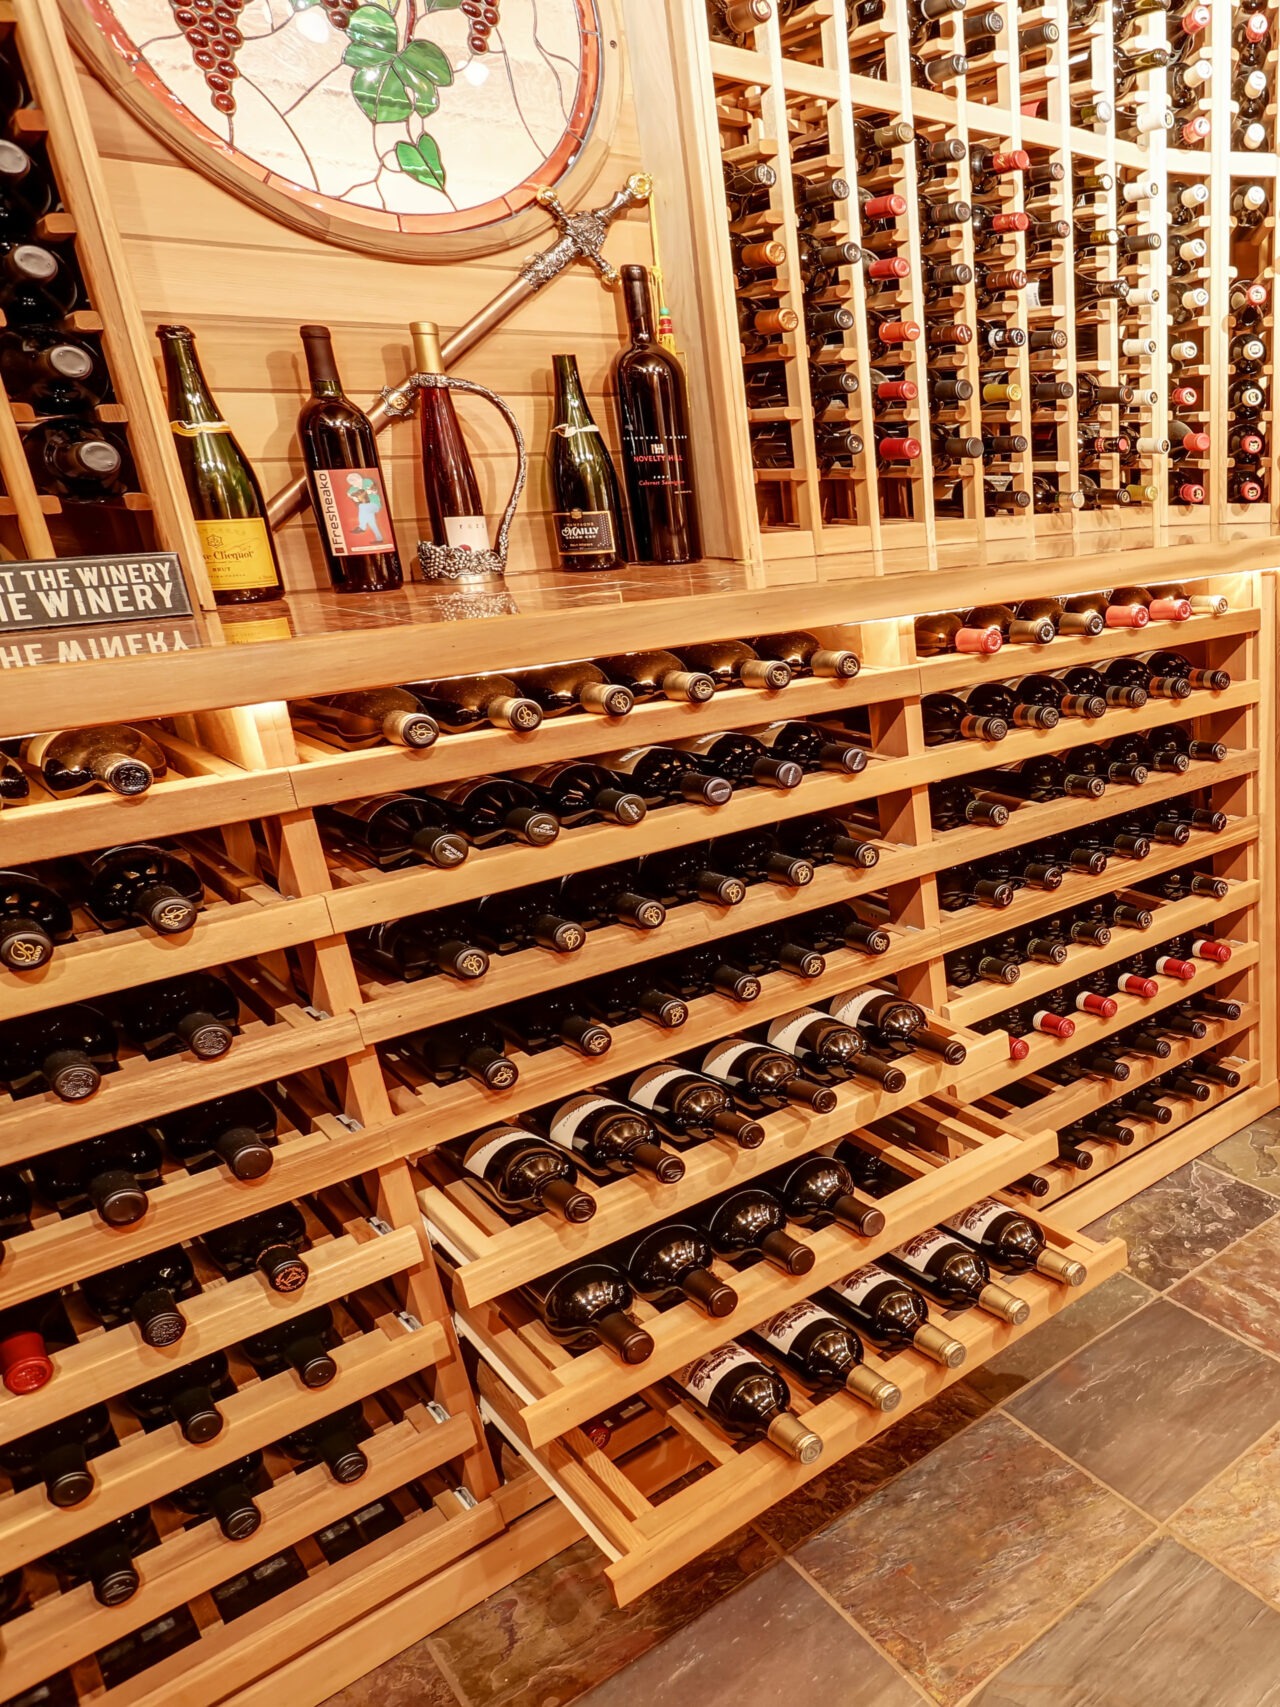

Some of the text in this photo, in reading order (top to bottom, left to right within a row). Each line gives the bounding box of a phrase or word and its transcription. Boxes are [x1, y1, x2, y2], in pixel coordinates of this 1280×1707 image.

[213, 550, 254, 561] Clicquot
[20, 568, 74, 591] THE
[75, 562, 171, 587] WINERY
[37, 582, 173, 618] WINERY
